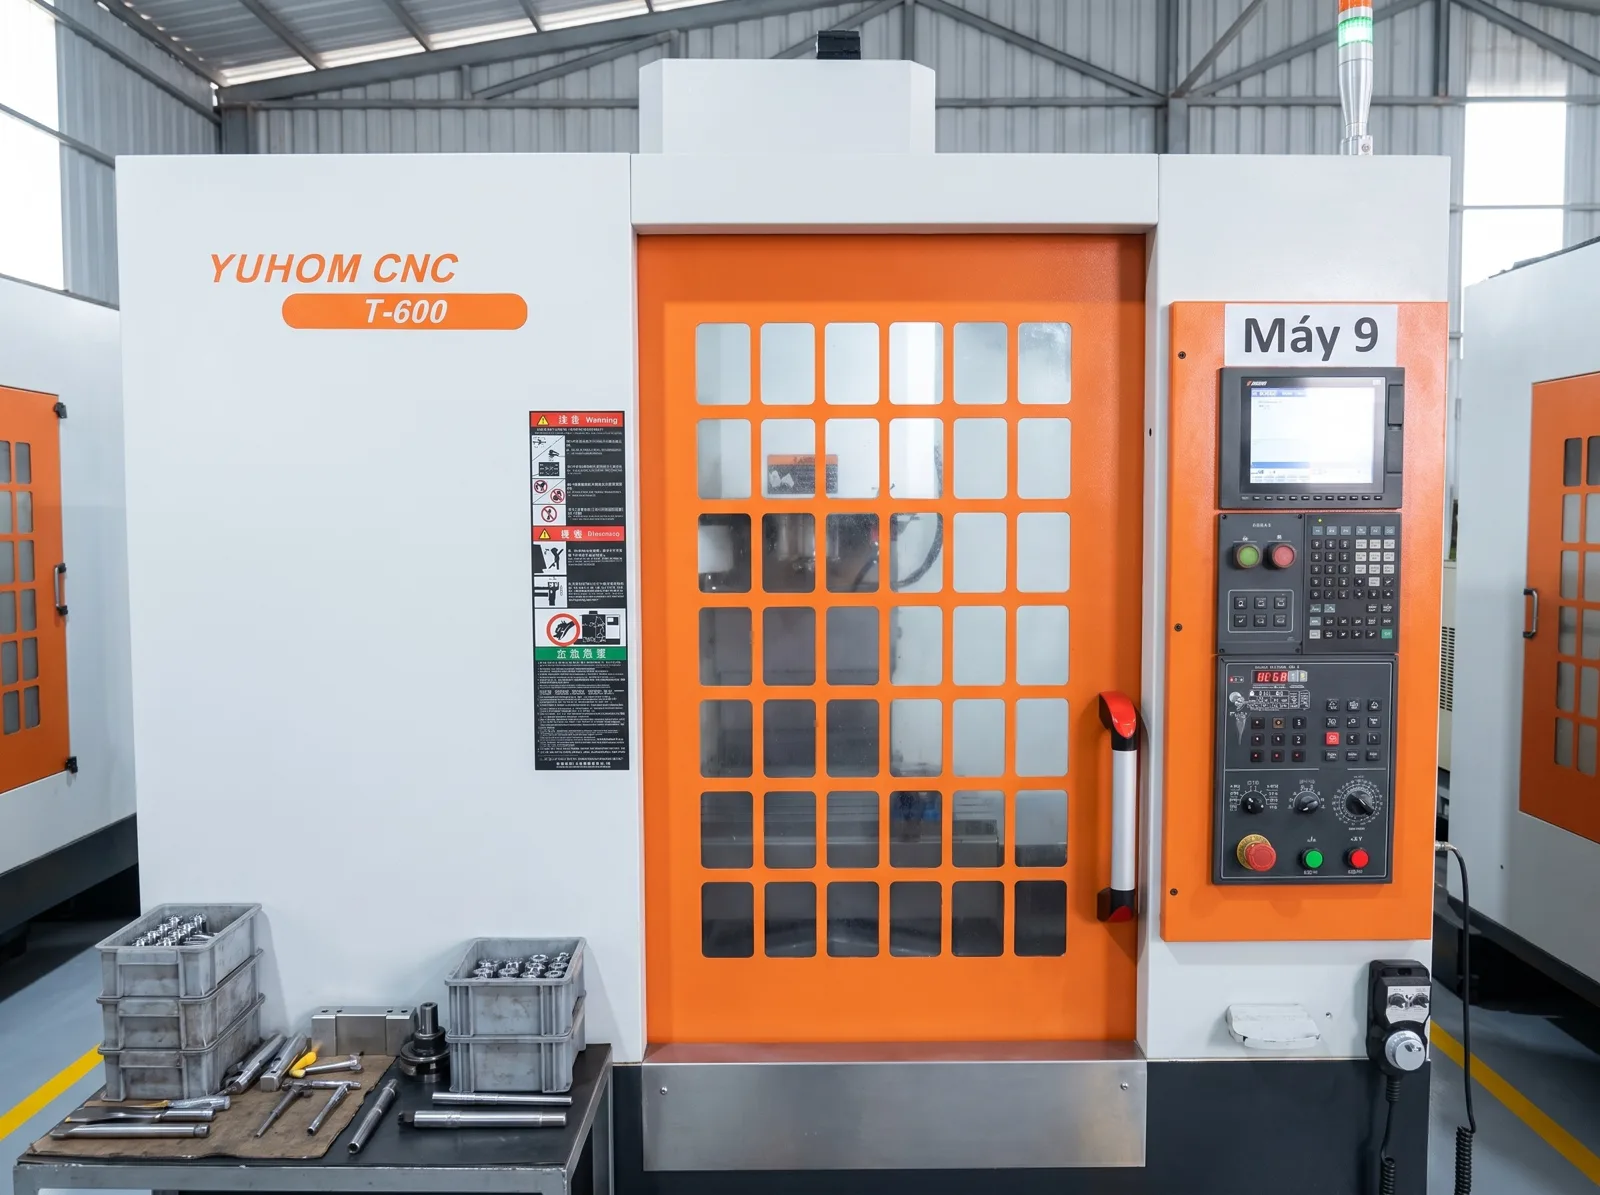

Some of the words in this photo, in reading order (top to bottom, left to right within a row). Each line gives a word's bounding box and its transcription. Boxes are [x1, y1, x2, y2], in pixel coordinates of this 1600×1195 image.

[210, 253, 362, 283] YUHOM
[373, 253, 459, 283] CNC
[365, 299, 448, 324] T-600
[1244, 315, 1341, 362] Máy
[1354, 317, 1379, 353] 9
